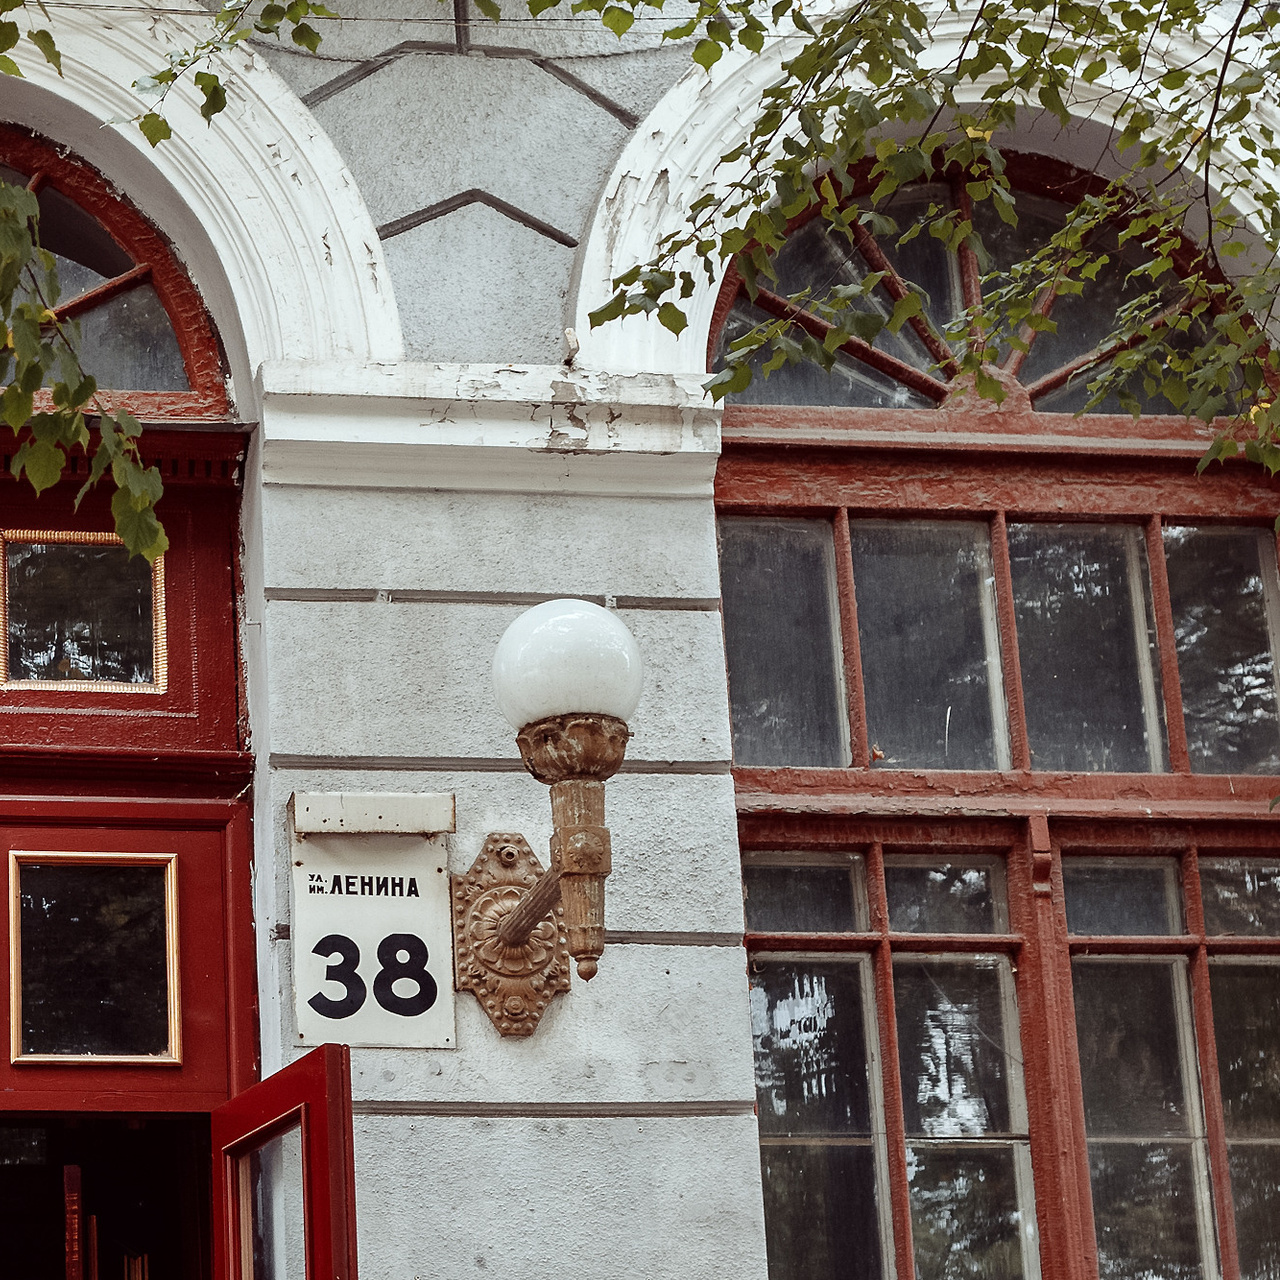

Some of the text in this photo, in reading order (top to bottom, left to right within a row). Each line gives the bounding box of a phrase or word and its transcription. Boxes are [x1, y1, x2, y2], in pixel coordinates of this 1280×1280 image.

[308, 873, 420, 898] УЛ. ИМ. ЛЕНИНА
[307, 933, 438, 1019] 38
